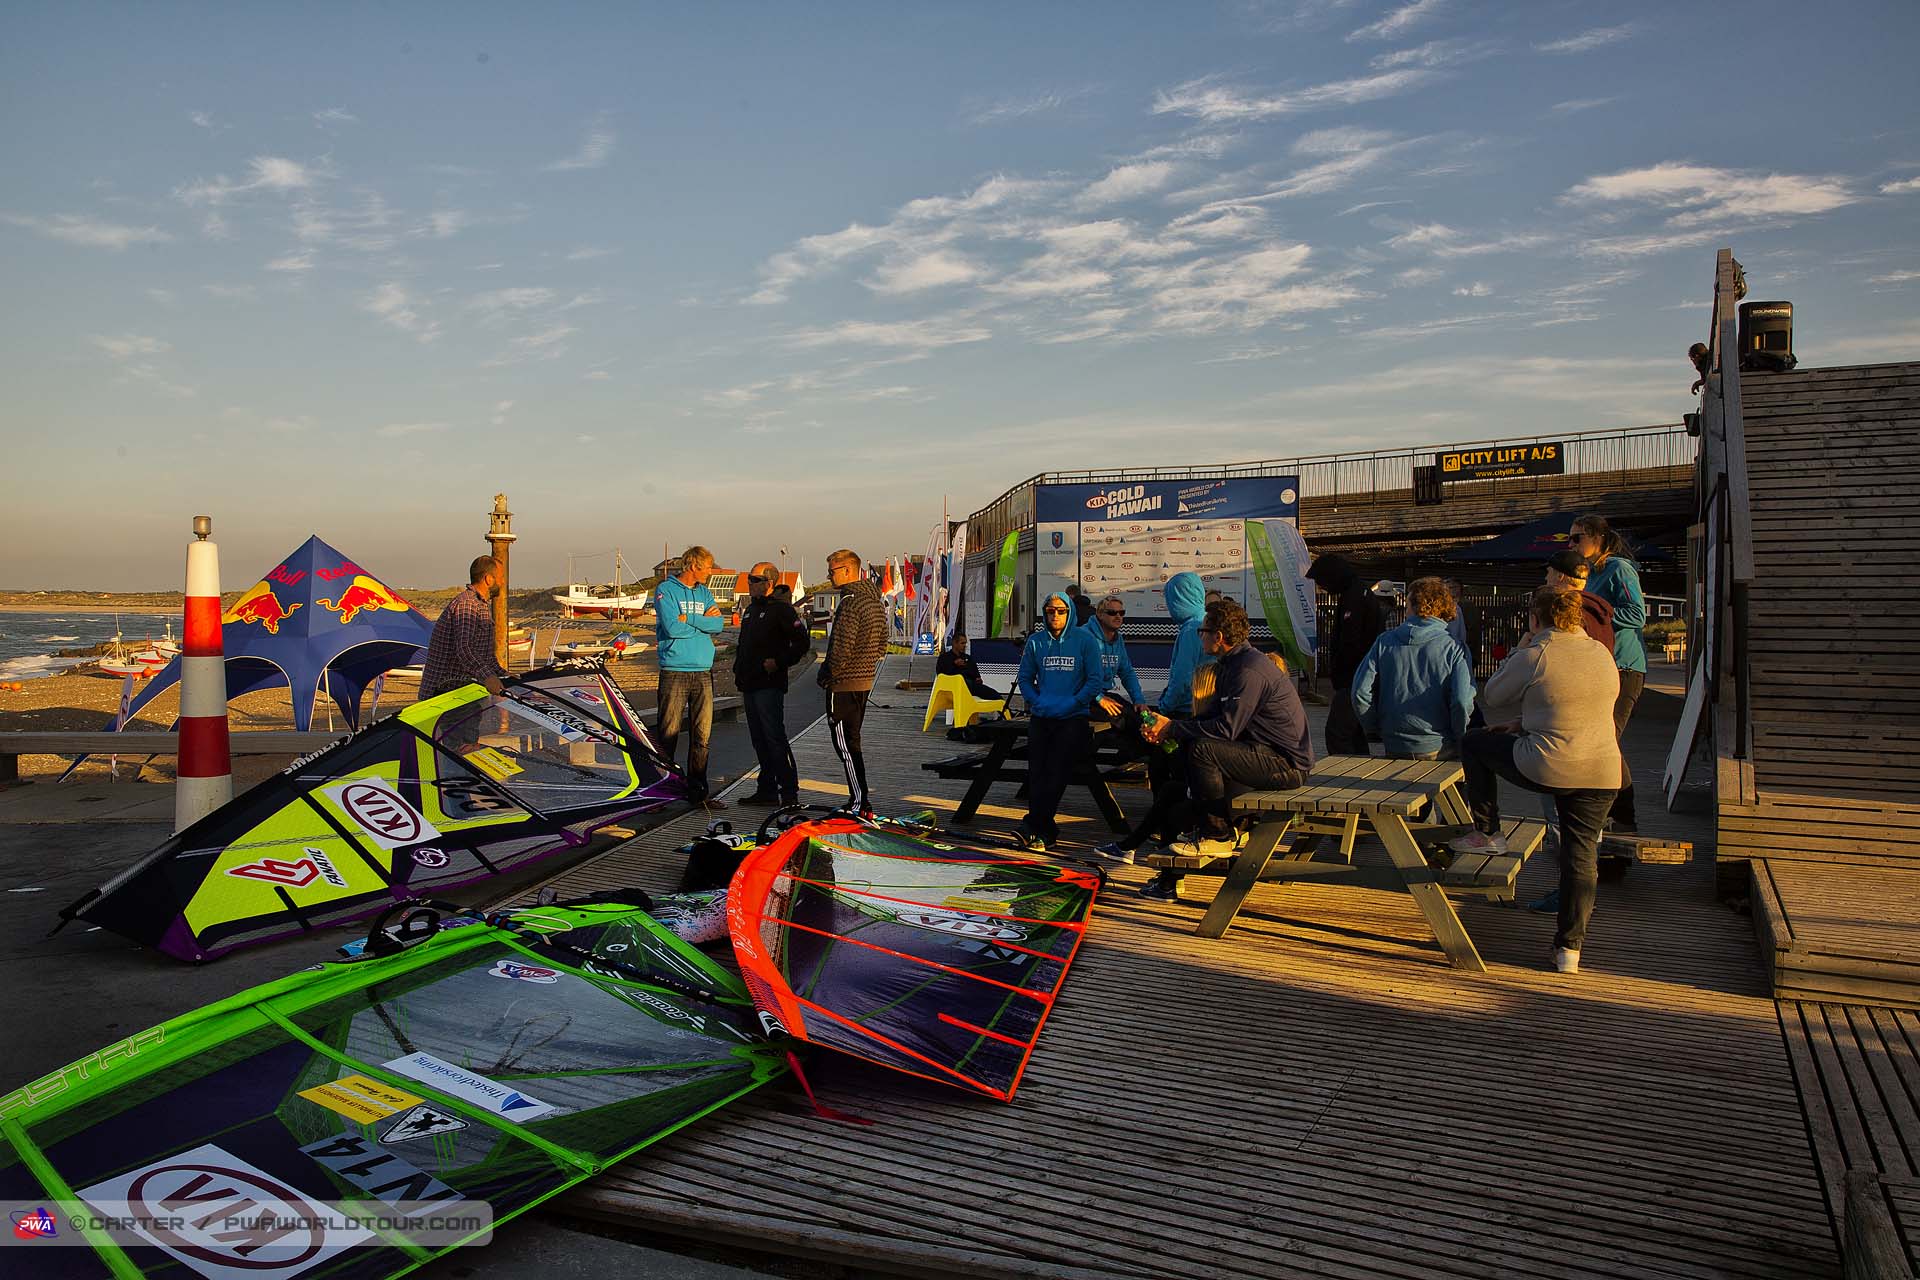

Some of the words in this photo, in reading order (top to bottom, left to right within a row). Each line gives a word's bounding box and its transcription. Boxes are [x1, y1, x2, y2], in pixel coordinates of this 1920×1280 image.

[1461, 451, 1494, 465] CITY
[1497, 448, 1528, 463] LIFT
[1531, 446, 1557, 460] A/S
[1475, 467, 1526, 477] www.citylift.dk
[1088, 497, 1106, 508] KIA
[1107, 485, 1145, 505] COLD
[1106, 495, 1162, 519] HAWAII
[269, 564, 308, 587] Bull
[315, 561, 356, 582] Red
[354, 790, 411, 833] KIA
[307, 848, 346, 887] FANATIC
[919, 915, 1003, 937] KIA
[158, 1173, 299, 1258] KIA
